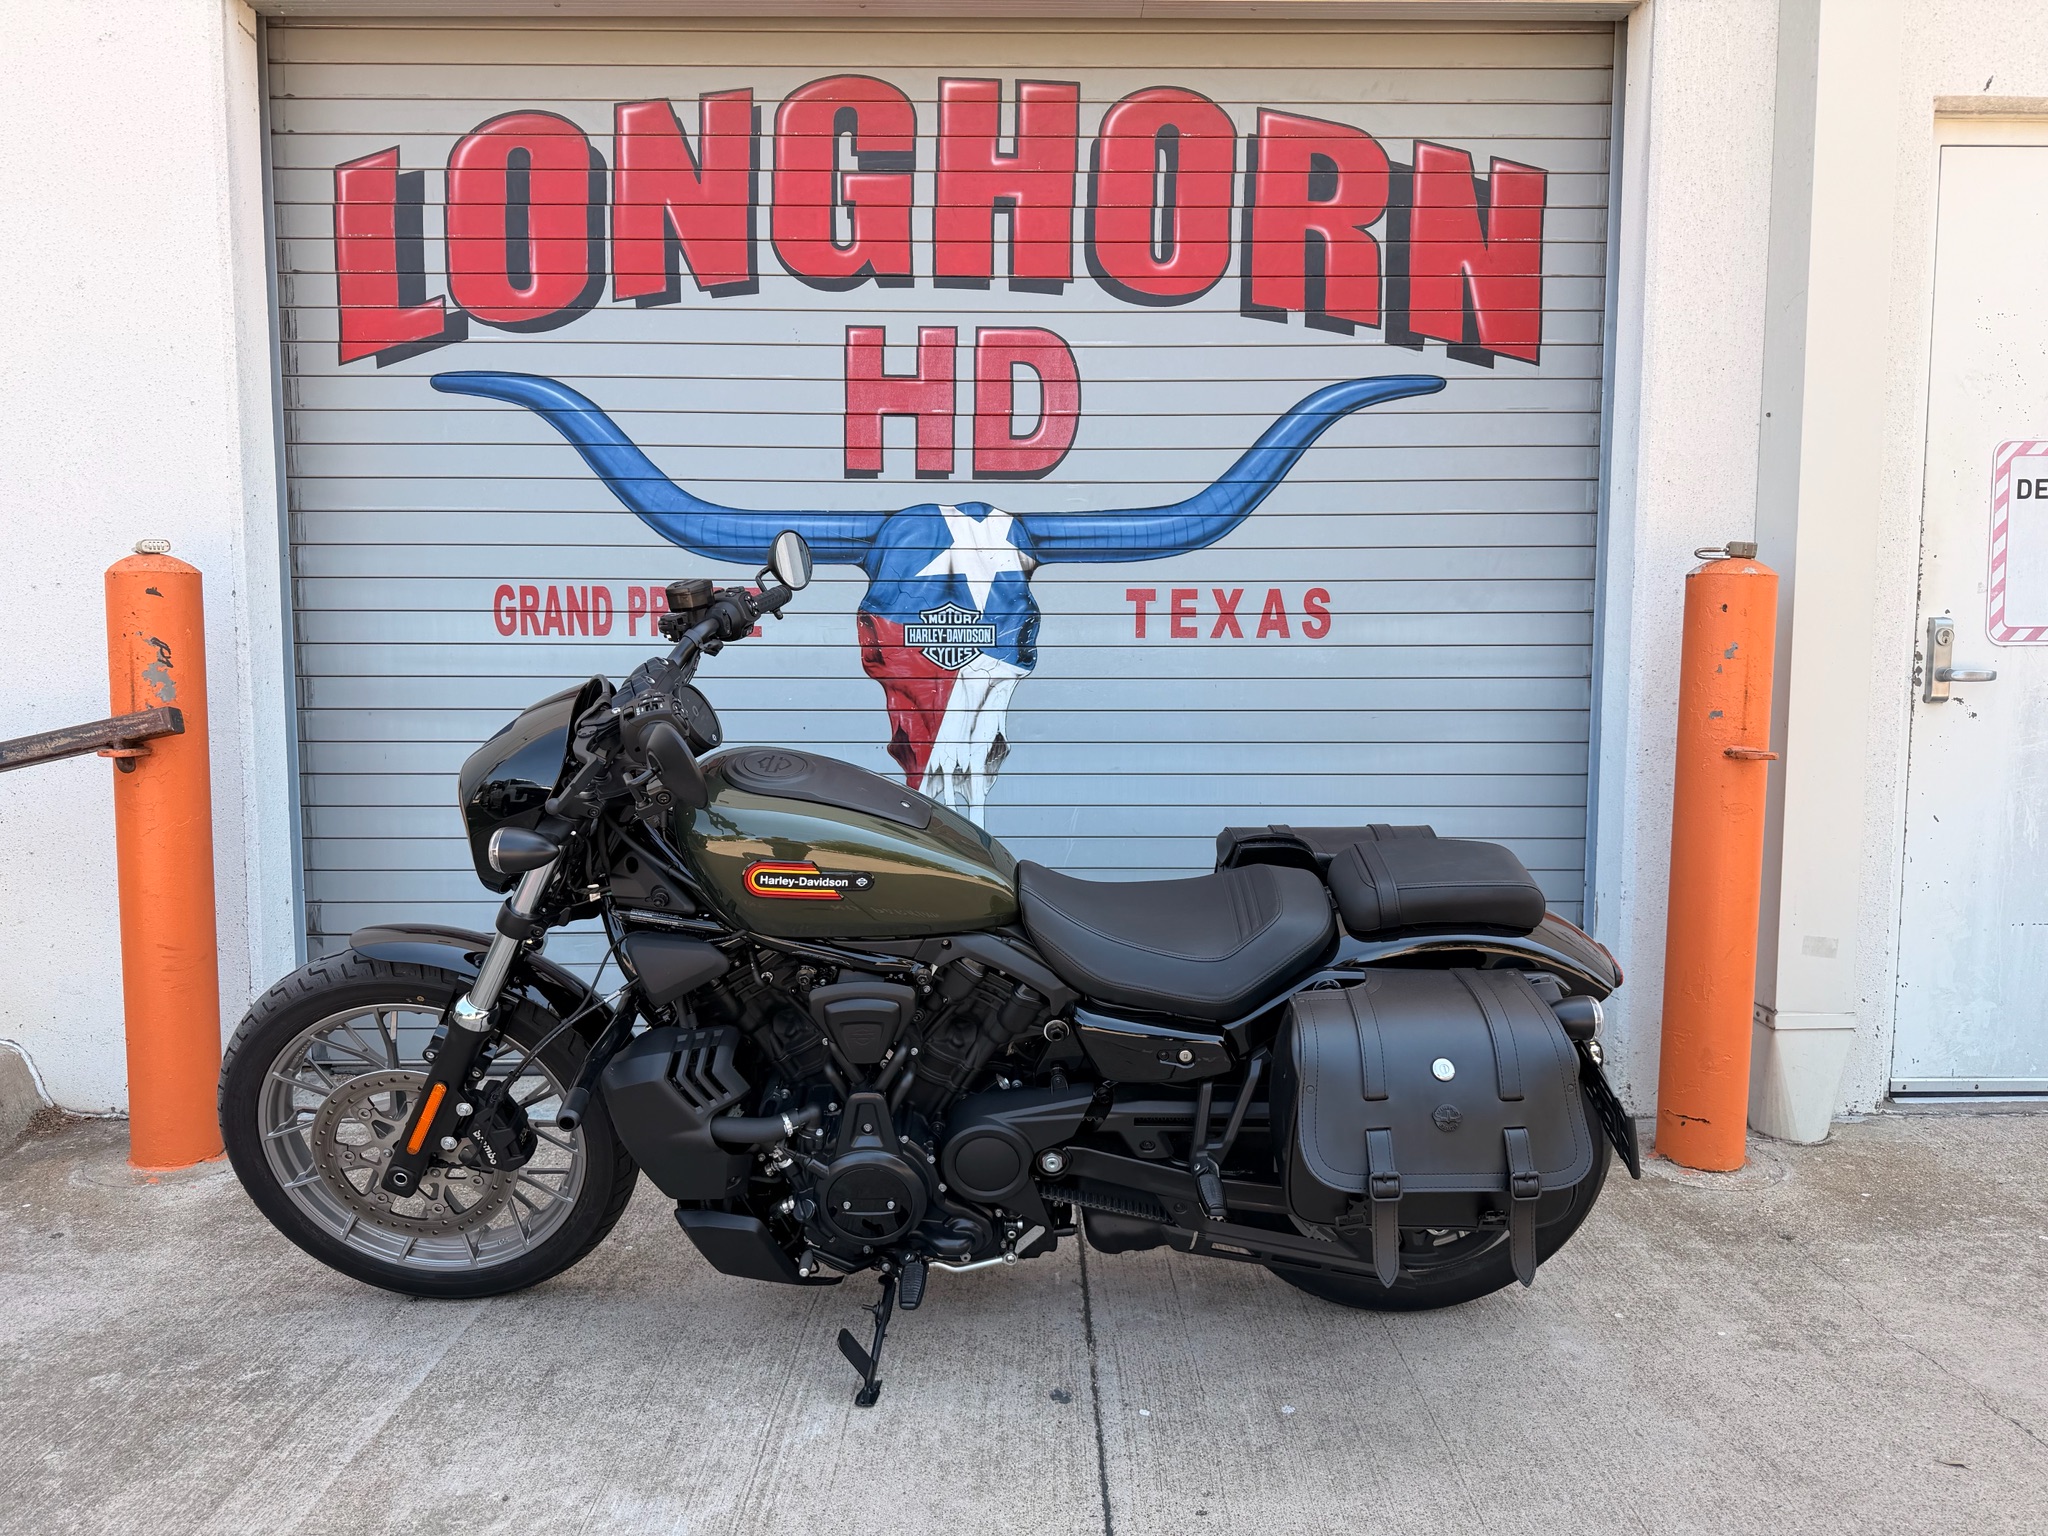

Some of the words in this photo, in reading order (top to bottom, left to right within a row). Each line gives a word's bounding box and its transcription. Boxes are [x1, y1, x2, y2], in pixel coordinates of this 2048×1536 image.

[334, 73, 1548, 369] LONGHORN
[844, 325, 1081, 480] HD
[2016, 478, 2048, 499] DE
[493, 583, 613, 637] GRAND
[928, 608, 972, 624] MOTOR
[1125, 587, 1332, 640] TEXAS
[908, 628, 991, 643] HARLEY-DAVIDSON
[928, 647, 973, 667] CYCLES
[759, 875, 849, 888] Harley-Davidson
